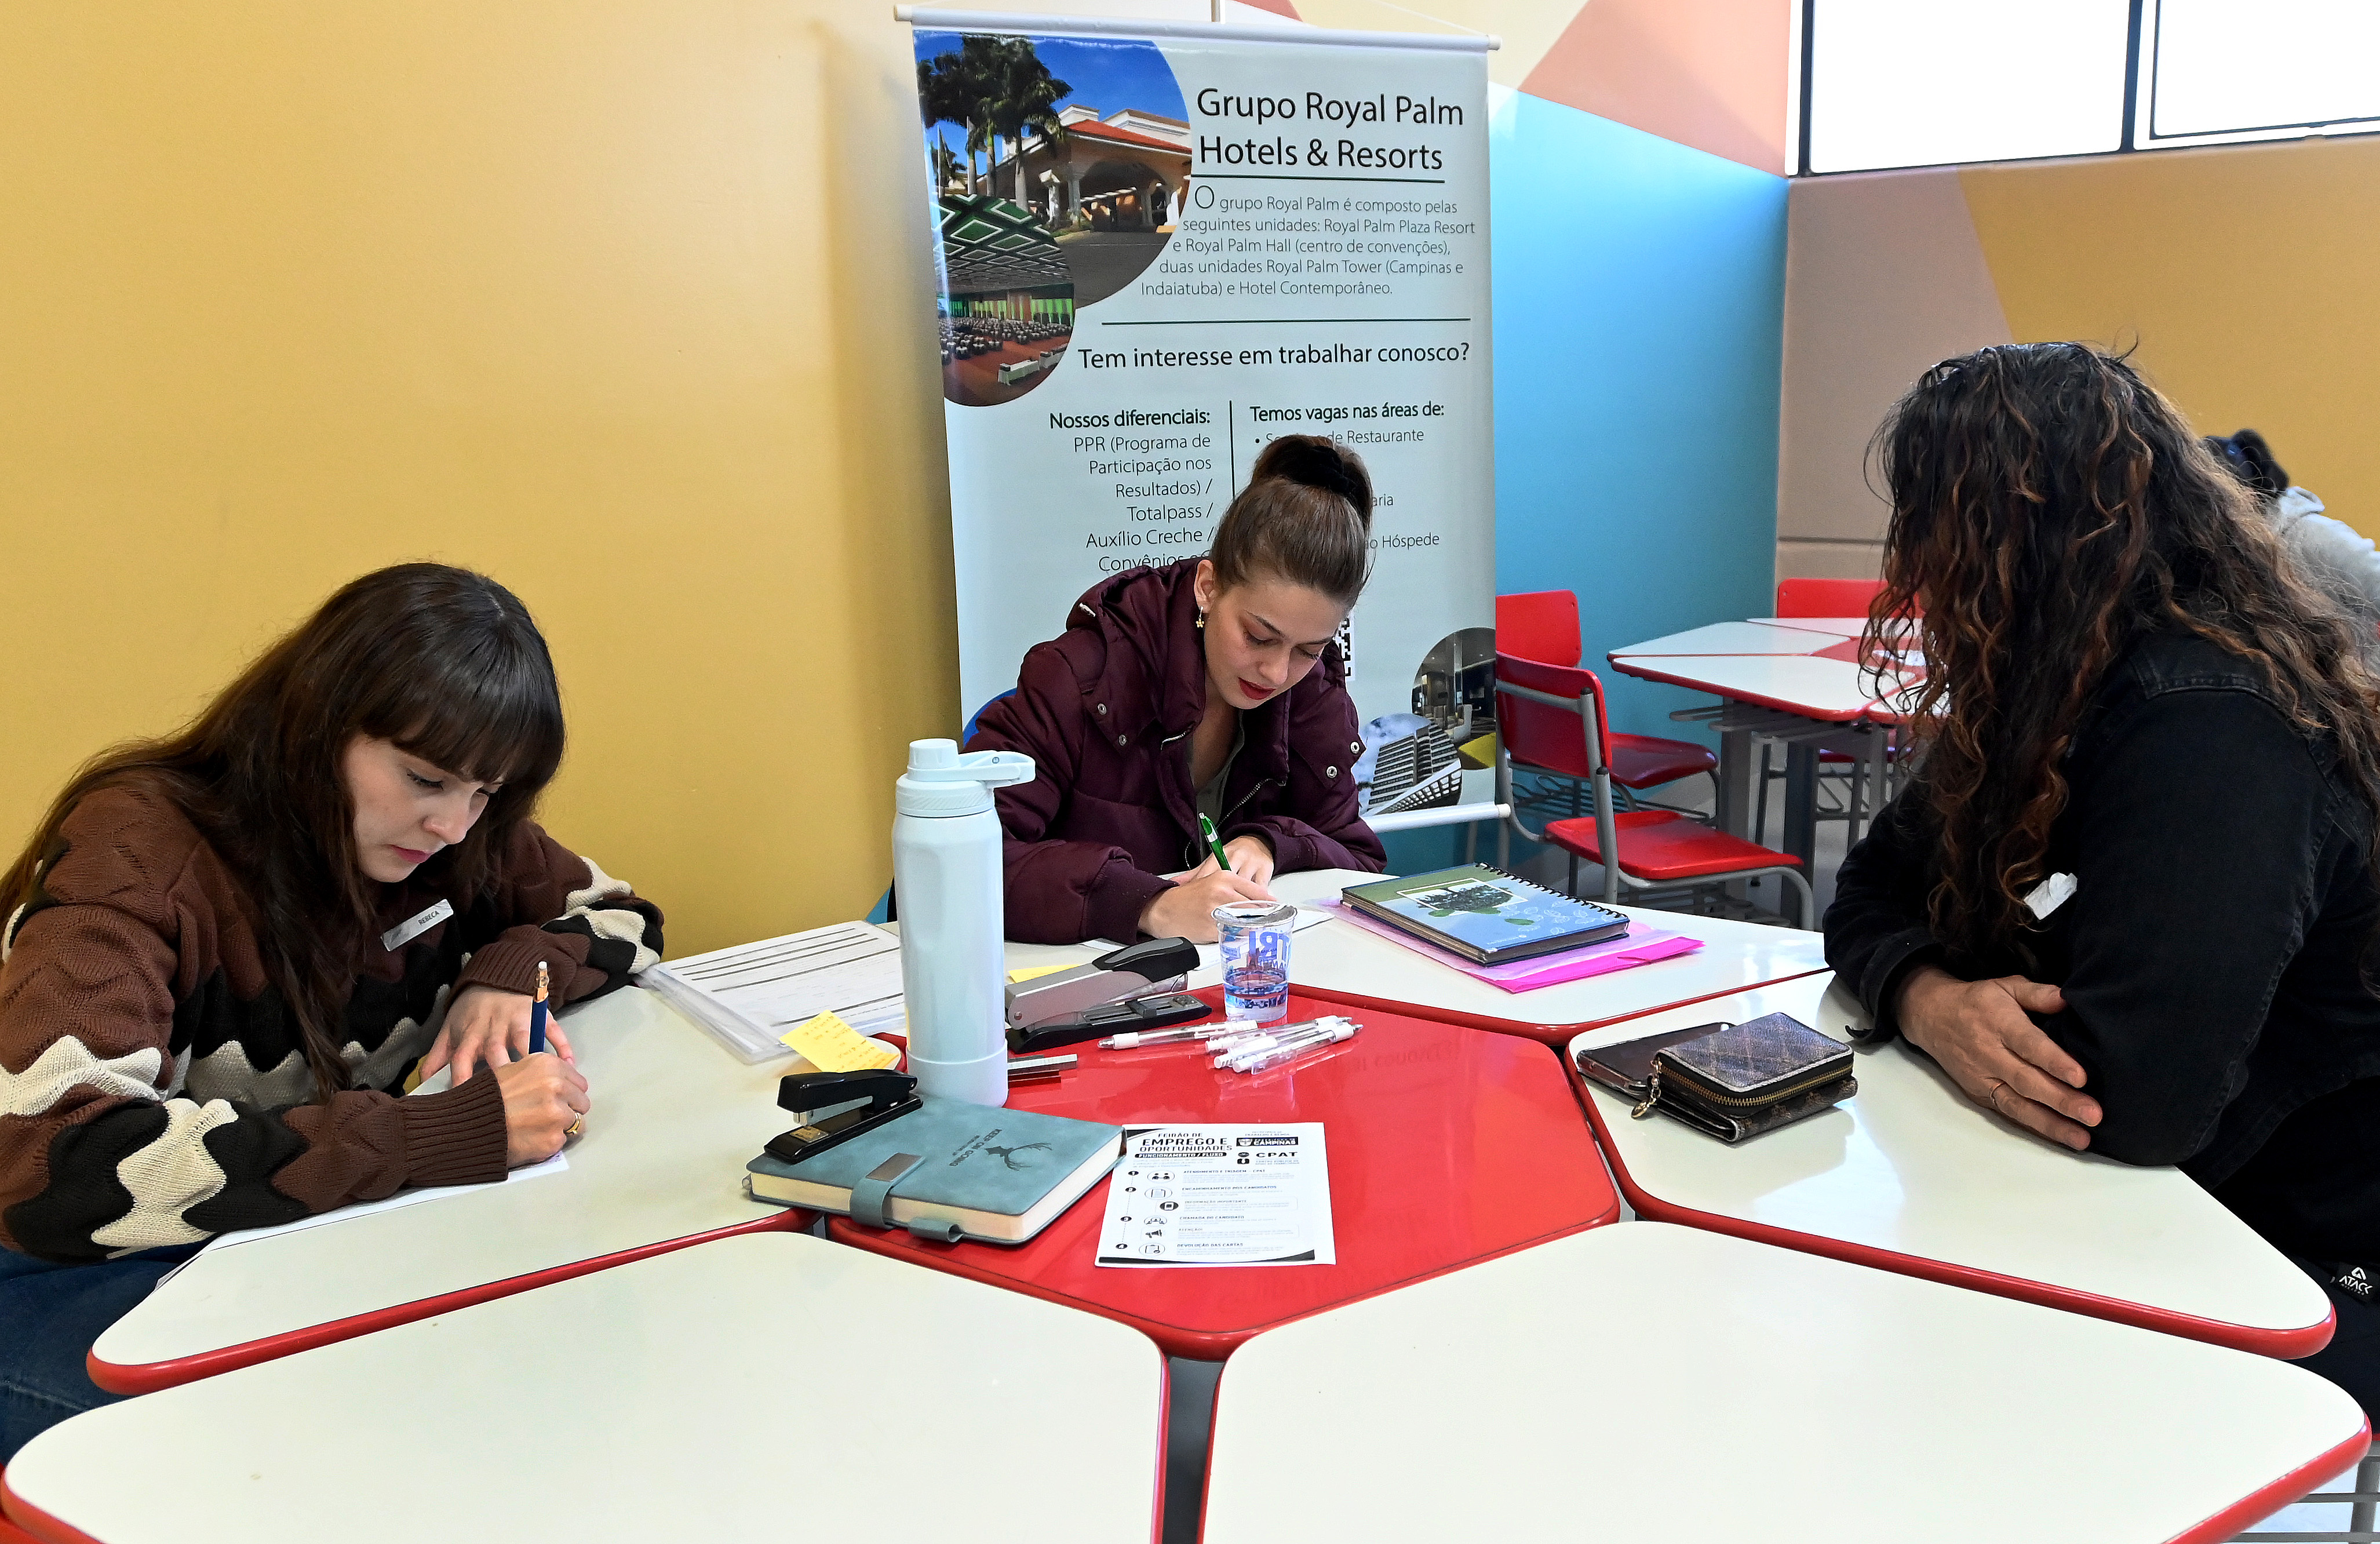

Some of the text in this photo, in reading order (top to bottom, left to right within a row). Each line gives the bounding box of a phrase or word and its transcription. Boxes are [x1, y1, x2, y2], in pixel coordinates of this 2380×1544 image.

[1197, 88, 1463, 129] Grupo Royal Palm
[1200, 135, 1442, 170] Hotels & Resorts
[1194, 185, 1457, 216] O grupo Royal Palm é composto pelas
[1183, 217, 1475, 236] seguintes unidades: Royal Palm Plaza Resort
[1173, 238, 1450, 257] e Royal Palm Hall (centro de convenções),
[1159, 258, 1463, 276] duas unidades Royal Palm Tower (Campinas e
[1142, 281, 1393, 297] Indaiatuba) e Hotel Contemporâneo.
[1077, 342, 1470, 369] Tem interesse em trabalhar conosco?
[1049, 408, 1211, 429] Nossos diferenciais:
[1249, 400, 1444, 424] Temos vagas nas áreas de:
[1074, 433, 1211, 454] PPR (Programa de
[1347, 429, 1424, 444] Restaurante
[1089, 457, 1212, 476] Participação nos
[1116, 479, 1201, 498] Resultados)
[1126, 504, 1202, 524] Totalpass
[1086, 530, 1142, 548] Auxílio
[1146, 527, 1202, 545] Creche
[1382, 531, 1440, 551] Hóspede
[1142, 1138, 1215, 1146] EMPREGO
[2339, 1275, 2373, 1294] ATACK
